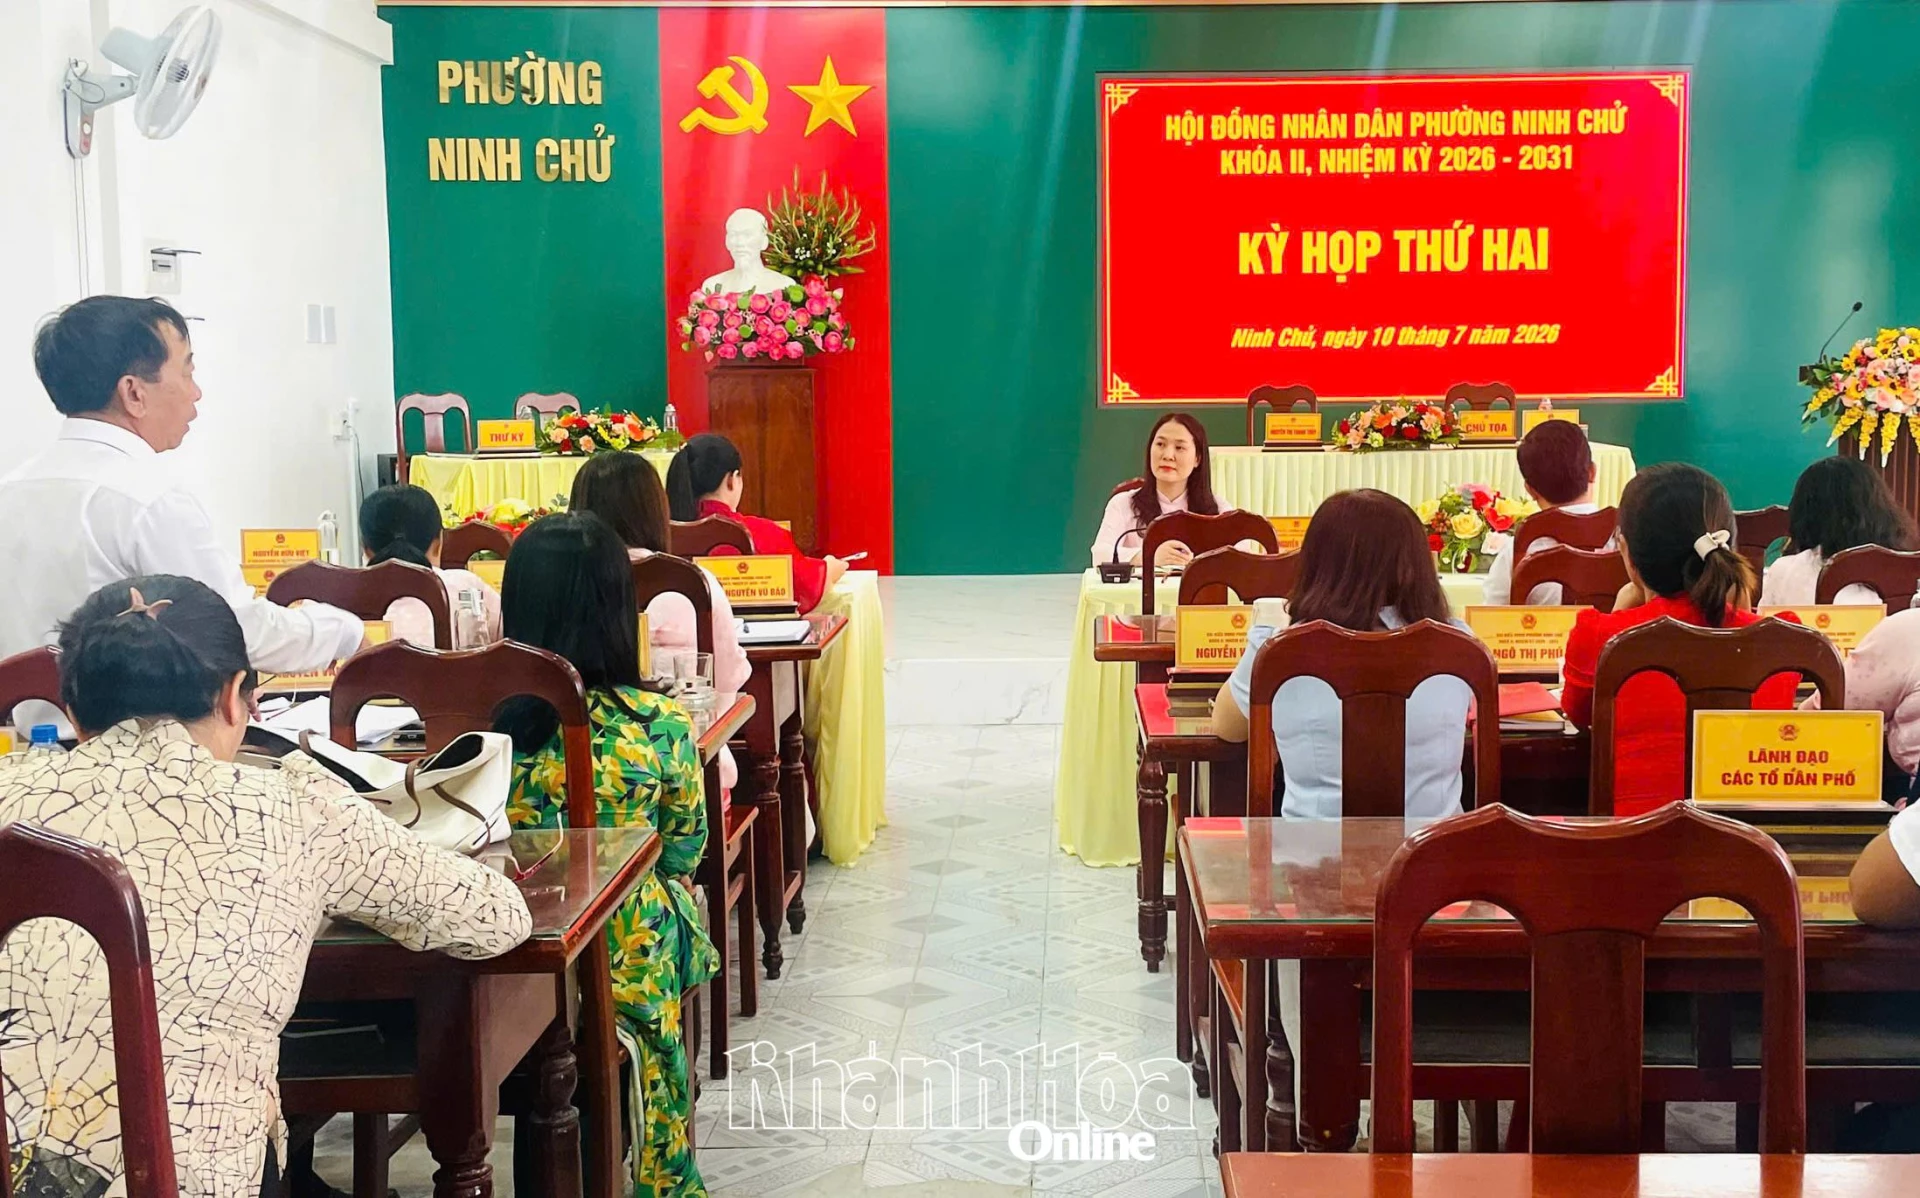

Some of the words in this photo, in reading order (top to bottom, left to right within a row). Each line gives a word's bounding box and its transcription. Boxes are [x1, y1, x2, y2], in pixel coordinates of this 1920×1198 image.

[438, 51, 602, 105] PHƯỜNG
[1165, 109, 1204, 146] HỘI
[1282, 108, 1347, 139] NHÂN
[1354, 107, 1403, 138] DÂN
[1410, 104, 1505, 137] PHƯỜNG
[1512, 109, 1570, 135] NINH
[1577, 99, 1629, 134] CHỬ
[428, 137, 521, 181] NINH
[535, 123, 615, 183] CHỬ
[1220, 144, 1283, 175] KHÓA
[1290, 149, 1312, 176] II,
[1319, 142, 1395, 179] NHIỆM
[1402, 141, 1433, 172] KỲ
[1438, 146, 1496, 172] 2026
[1518, 145, 1573, 170] 2031
[1238, 222, 1290, 275] KỲ
[1301, 230, 1382, 283] HỌP
[1393, 220, 1475, 272] THỨ
[1482, 227, 1549, 271] HAI
[1231, 327, 1274, 348] Ninh
[1322, 325, 1368, 349] ngày
[1372, 326, 1395, 347] 10
[1397, 325, 1450, 348] tháng
[1453, 325, 1467, 345] 7
[1468, 324, 1511, 345] năm
[1512, 324, 1561, 344] 2026
[1721, 769, 1754, 786] CÁC
[1822, 769, 1856, 787] PHỐ
[1748, 748, 1791, 764] LÃNH
[1796, 750, 1829, 766] ĐẠO
